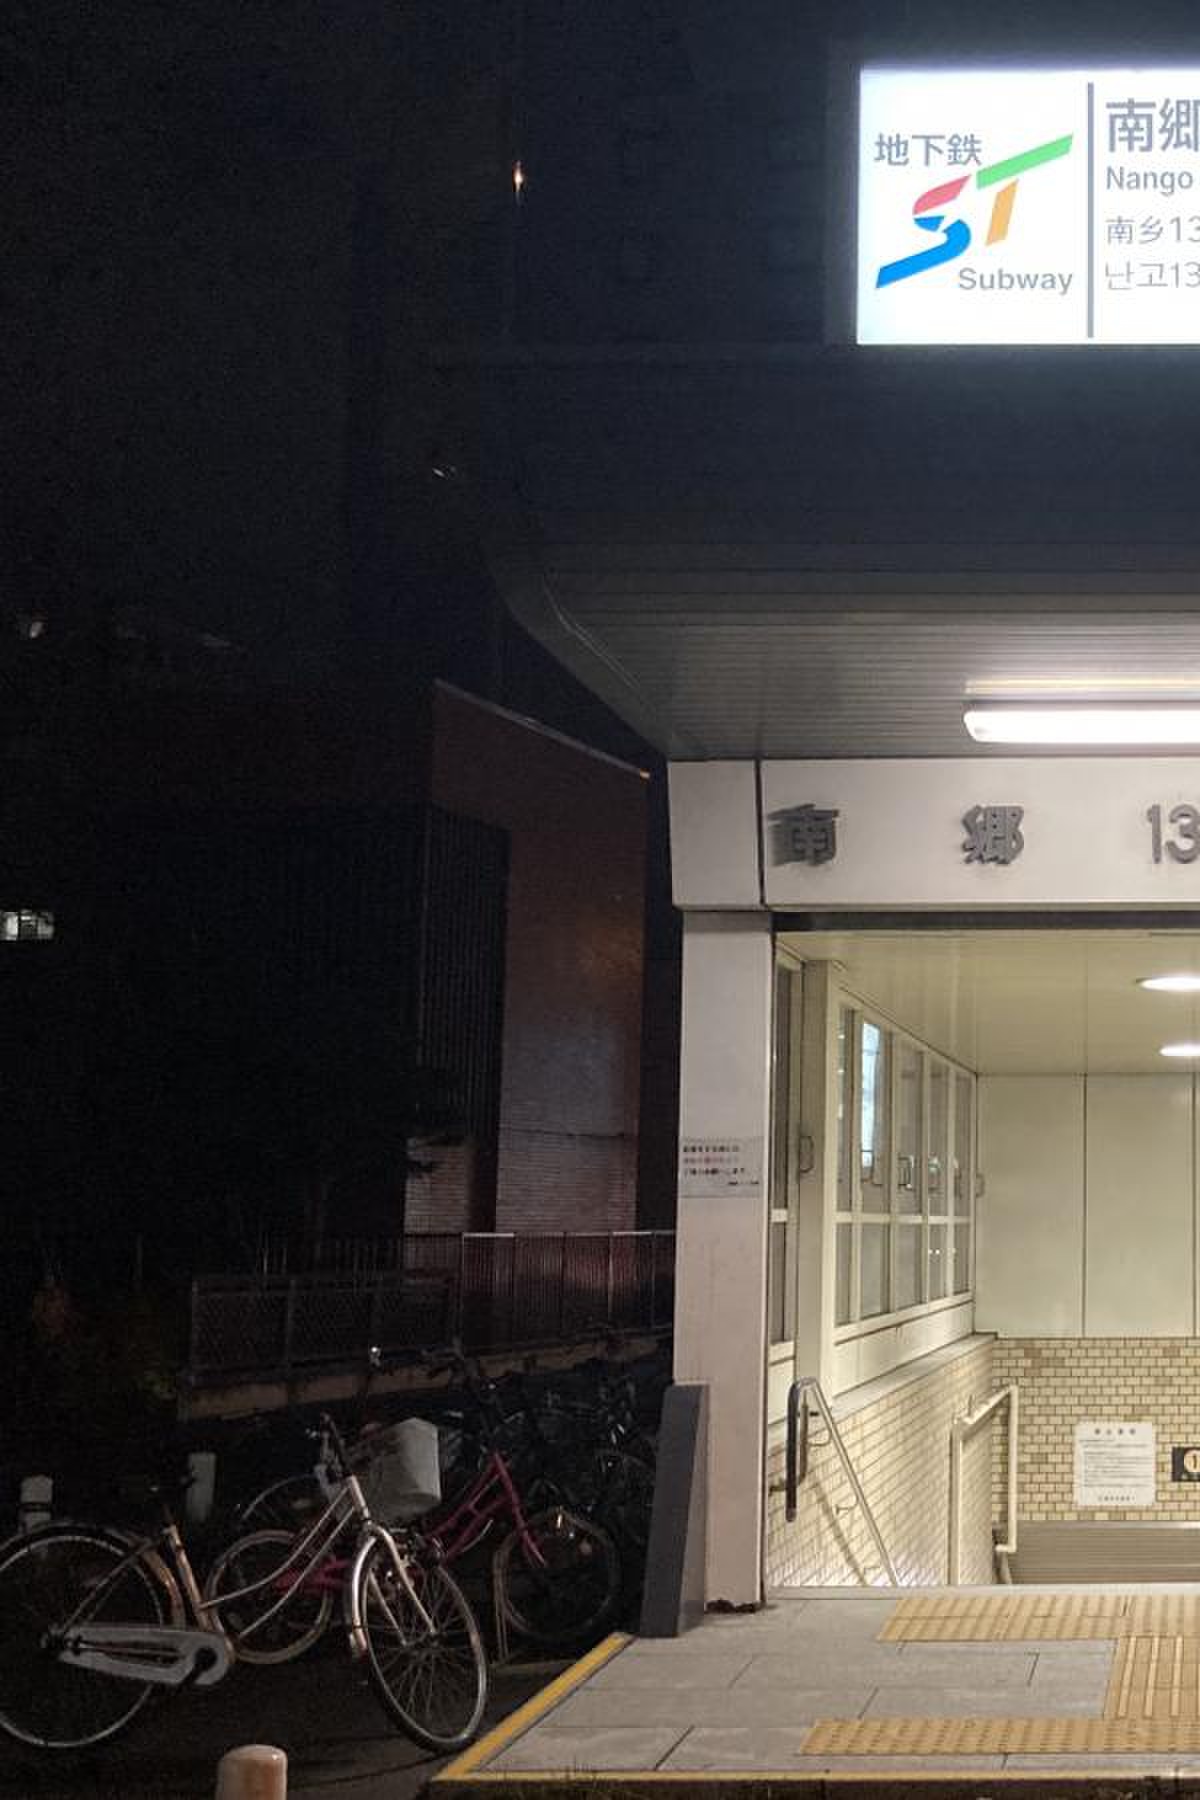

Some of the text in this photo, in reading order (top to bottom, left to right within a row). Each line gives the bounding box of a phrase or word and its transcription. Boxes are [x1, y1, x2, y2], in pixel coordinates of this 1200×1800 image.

[874, 133, 983, 167] 地下鉄
[1105, 166, 1194, 197] Nango
[959, 267, 1073, 296] Subway
